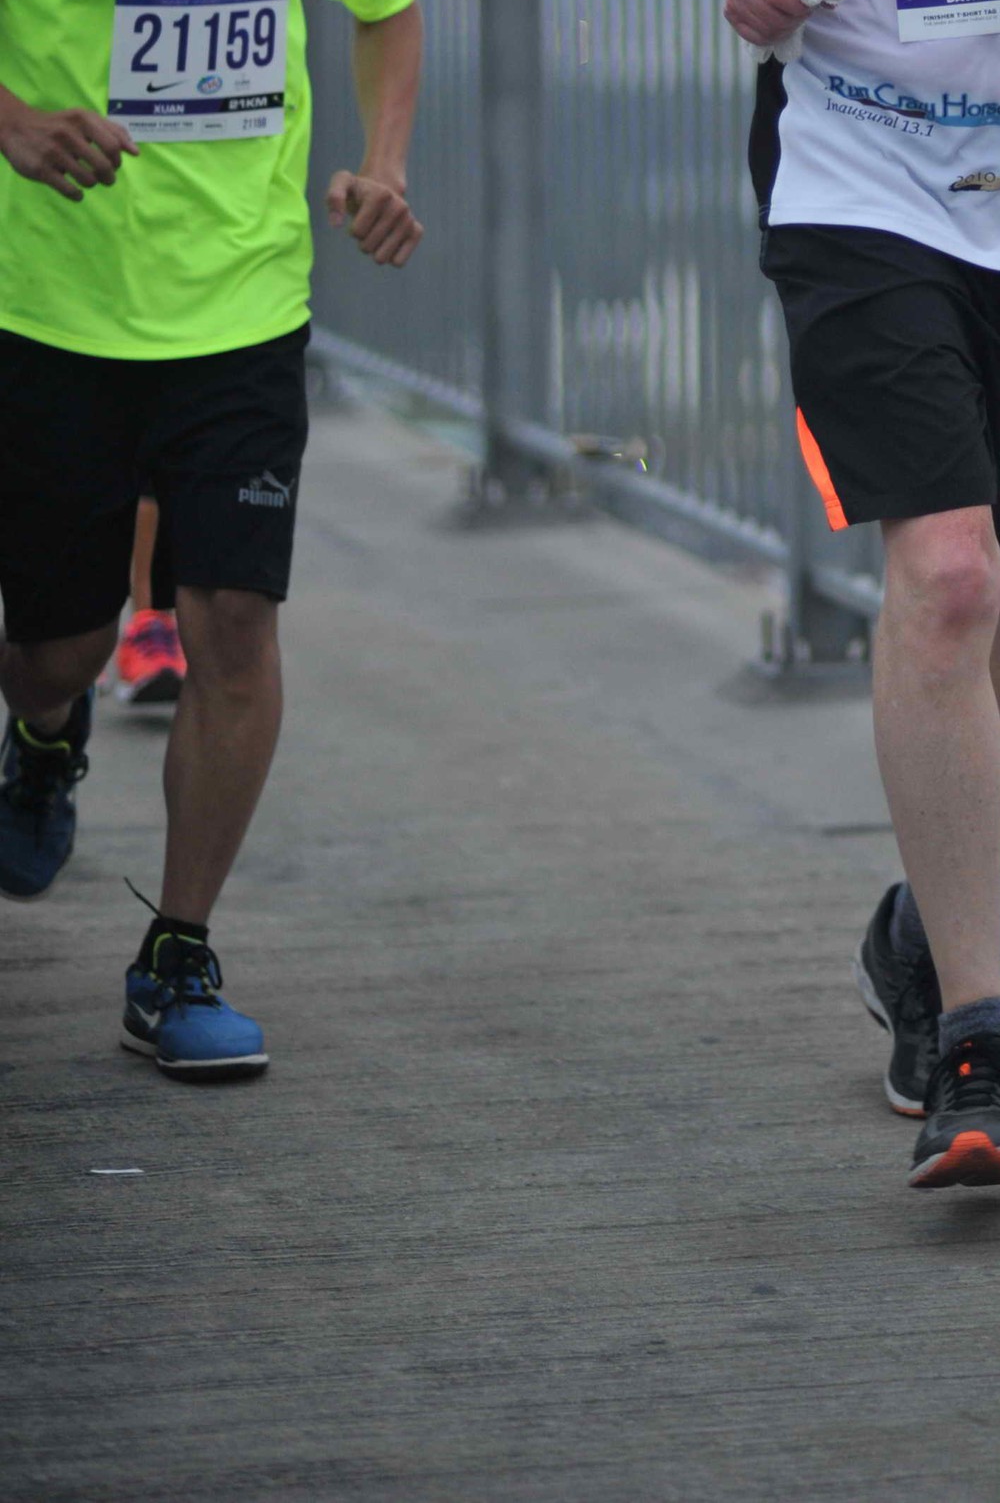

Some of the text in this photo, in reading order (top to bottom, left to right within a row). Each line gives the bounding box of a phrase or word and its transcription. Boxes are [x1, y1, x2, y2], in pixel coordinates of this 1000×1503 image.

[131, 7, 276, 73] 21159
[153, 104, 185, 114] XUAN
[825, 98, 935, 138] Inaugural 13.1
[956, 171, 996, 185] 2010
